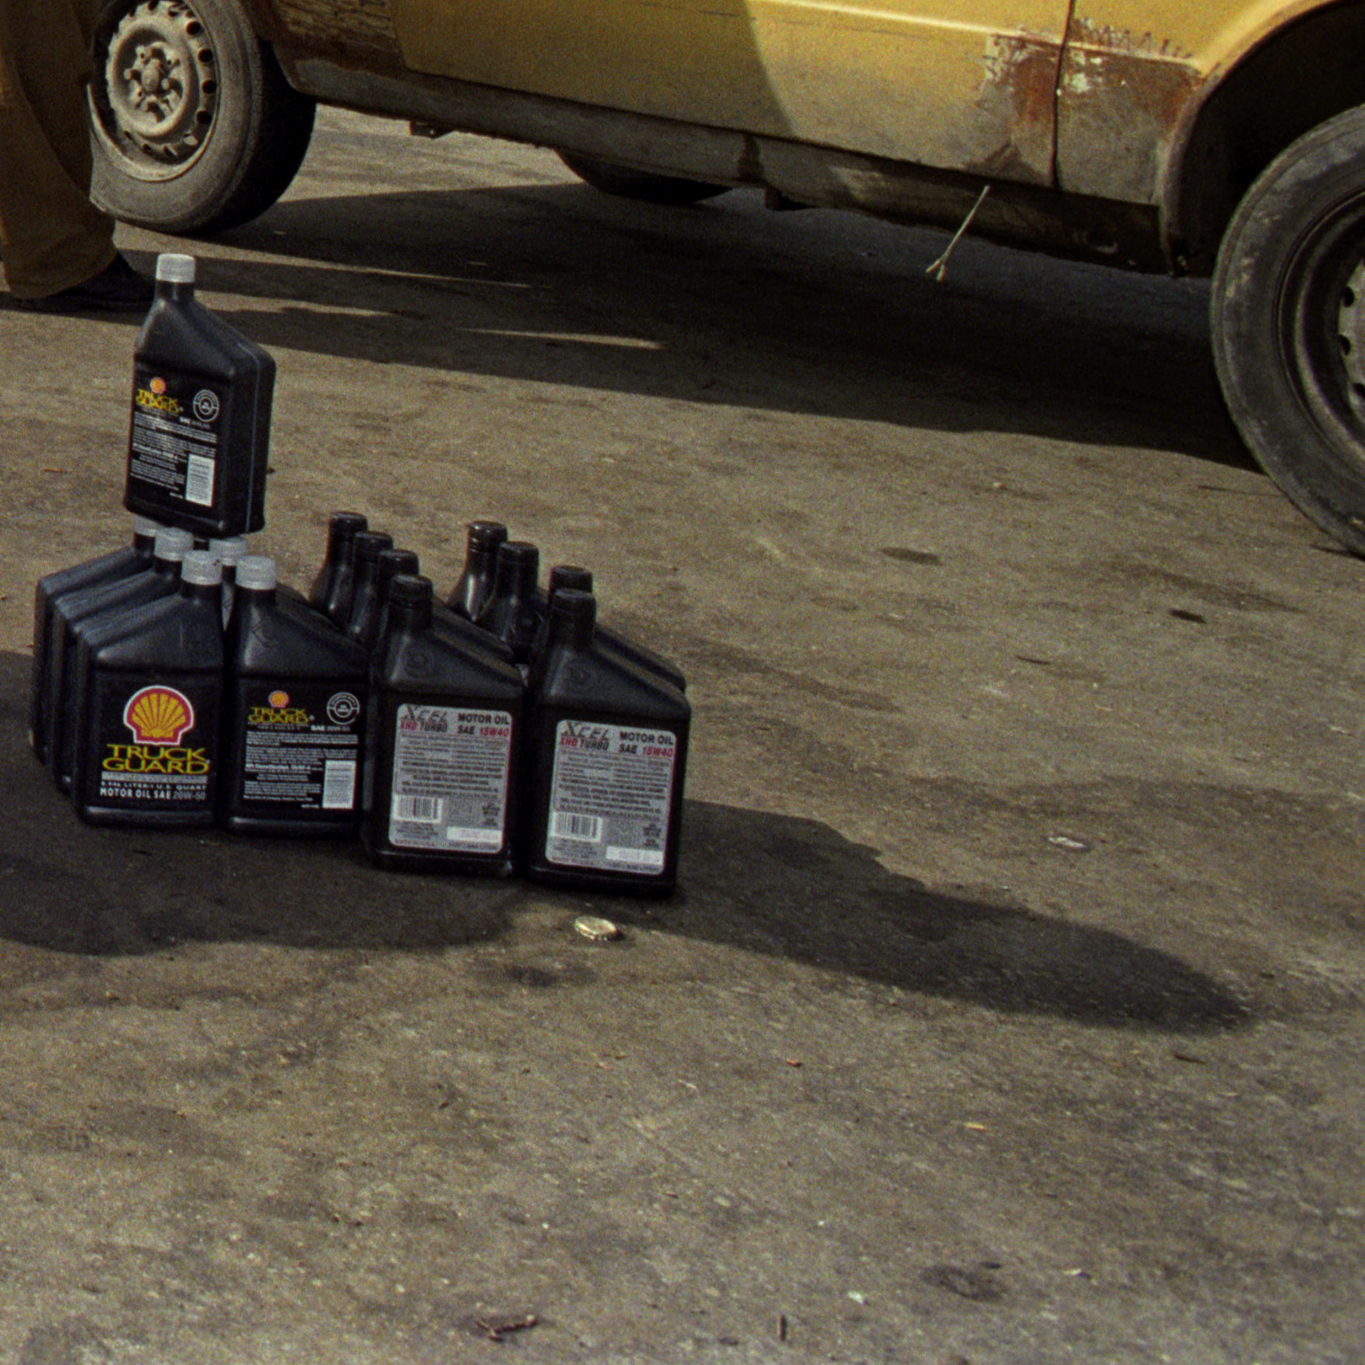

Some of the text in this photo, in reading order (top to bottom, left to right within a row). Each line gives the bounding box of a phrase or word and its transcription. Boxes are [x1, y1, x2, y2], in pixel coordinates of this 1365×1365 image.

[136, 395, 179, 413] GUARD
[137, 389, 178, 405] TRUCK
[247, 714, 310, 725] GUARD
[250, 706, 307, 717] TRUCK
[457, 712, 492, 724] MOTOR
[493, 714, 510, 725] OIL
[419, 722, 448, 733] TURBO
[457, 725, 475, 735] SAE
[479, 727, 510, 738] 15W40
[619, 730, 656, 743] MOTOR
[657, 734, 674, 746] OIL
[106, 743, 207, 762] TRUCK
[579, 738, 609, 751] TURBO
[618, 744, 638, 755] SAE
[642, 746, 674, 757] 15W40
[102, 757, 210, 774] GUARD
[99, 787, 133, 798] MOTOR
[135, 788, 151, 799] OIL
[153, 789, 172, 800] SAE
[175, 783, 207, 791] QUART
